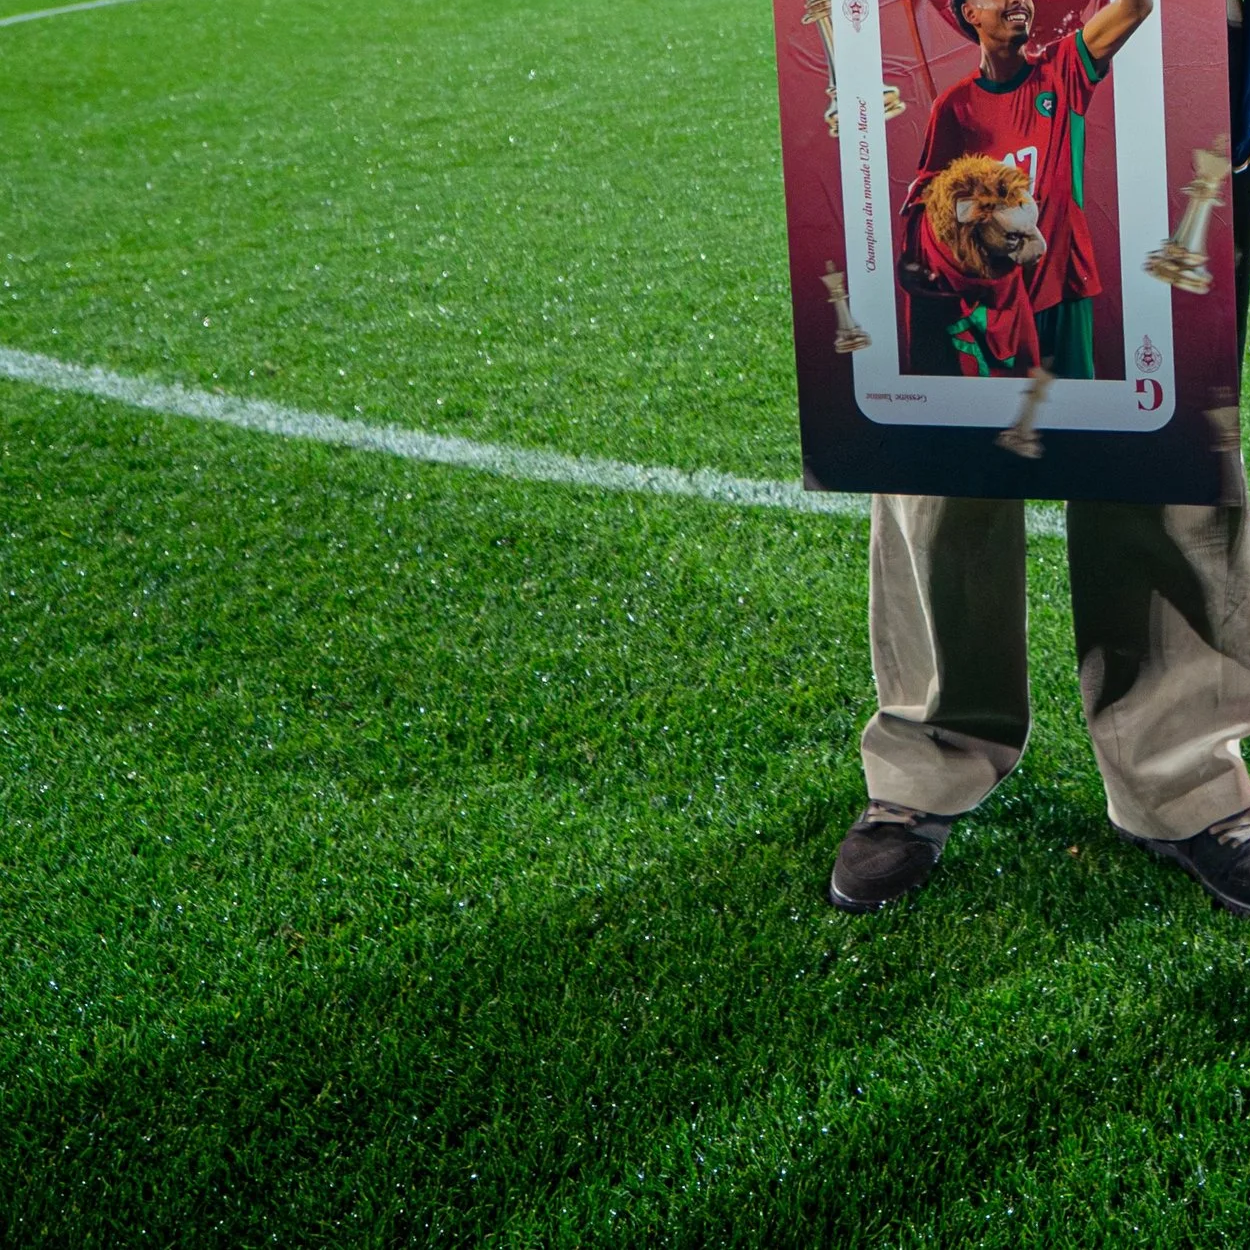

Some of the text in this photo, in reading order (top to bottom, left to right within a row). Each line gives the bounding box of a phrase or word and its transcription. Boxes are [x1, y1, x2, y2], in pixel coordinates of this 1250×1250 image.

[859, 140, 870, 161] U20
[860, 164, 873, 200] monde
[862, 202, 873, 216] du
[1135, 378, 1164, 411] G
